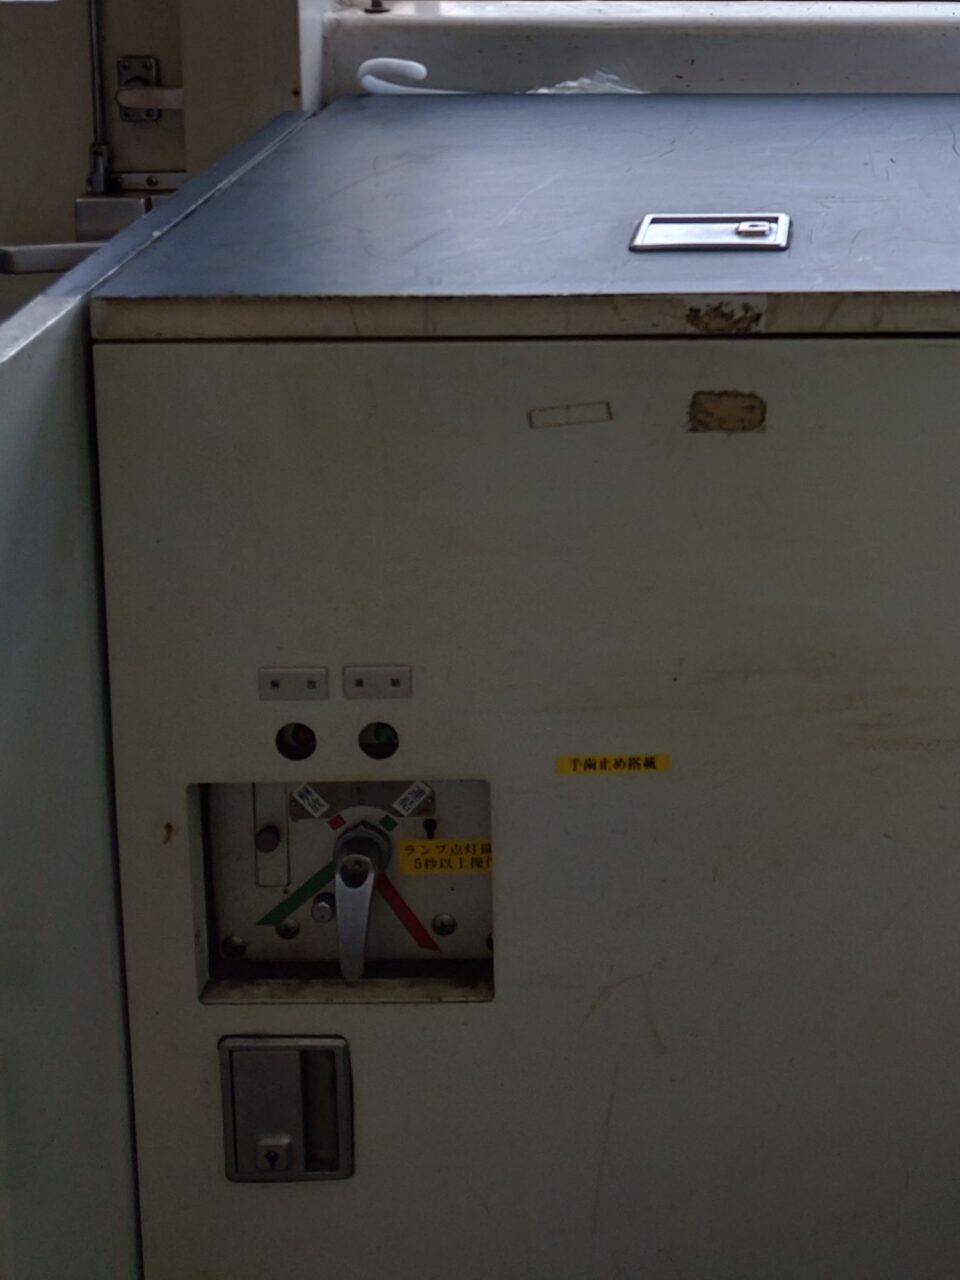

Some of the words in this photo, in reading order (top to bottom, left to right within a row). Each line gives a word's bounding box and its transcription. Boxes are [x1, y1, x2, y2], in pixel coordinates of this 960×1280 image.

[572, 755, 657, 771] 手歯止め搭載
